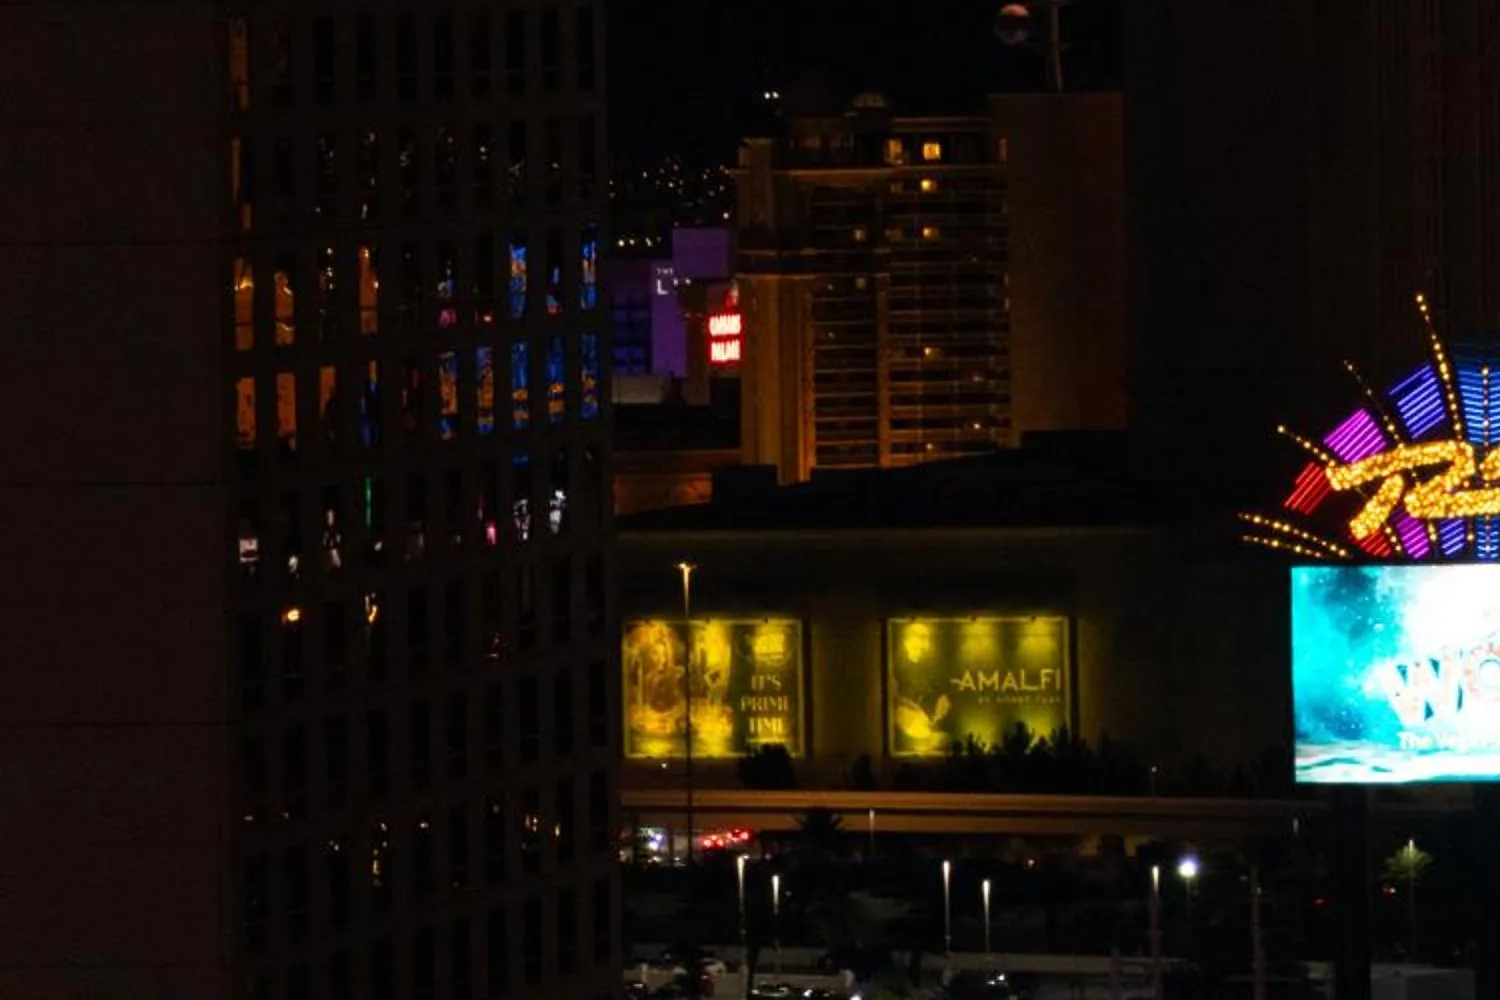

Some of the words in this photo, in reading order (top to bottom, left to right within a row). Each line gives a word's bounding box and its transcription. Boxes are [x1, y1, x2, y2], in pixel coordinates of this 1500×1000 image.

[751, 674, 782, 691] IT'S
[950, 668, 1061, 692] AMALFI
[741, 695, 790, 712] PRIME
[748, 716, 783, 734] TIME
